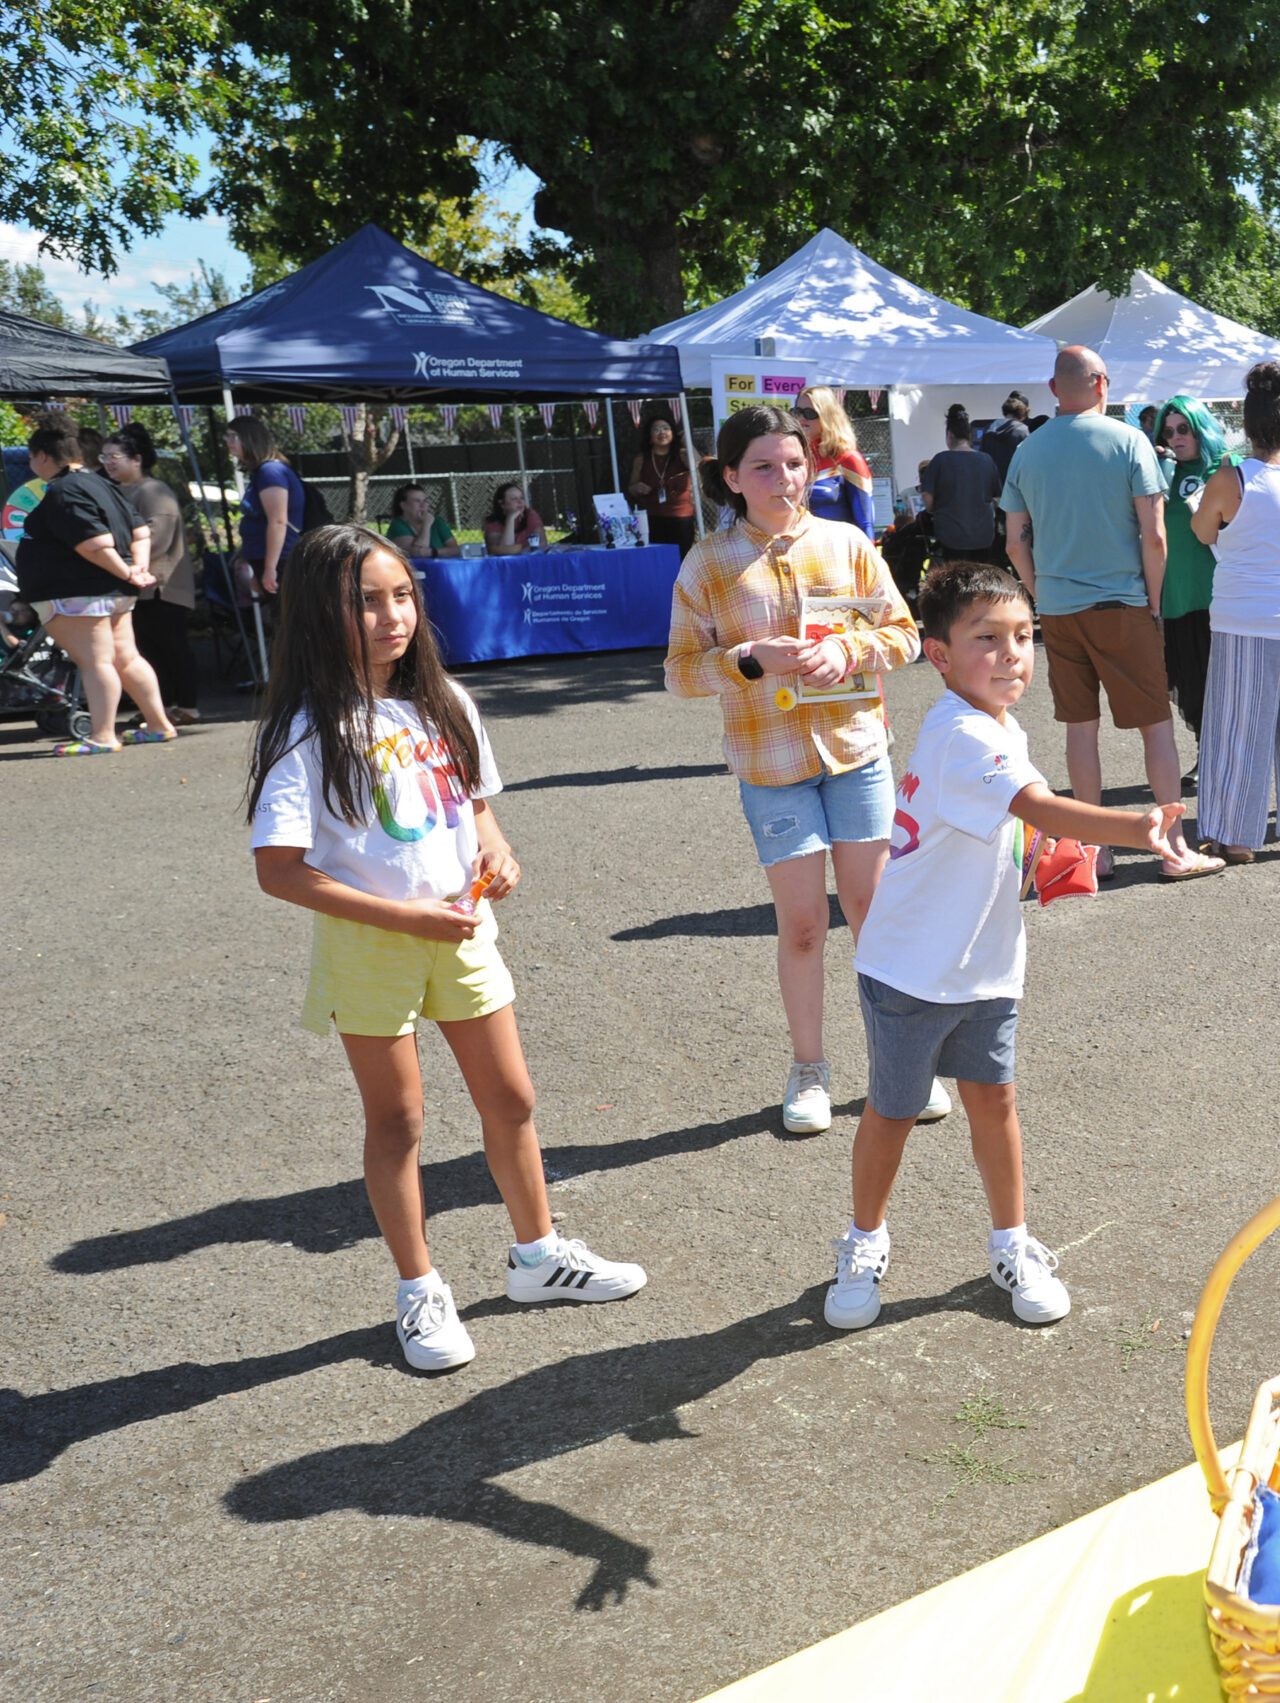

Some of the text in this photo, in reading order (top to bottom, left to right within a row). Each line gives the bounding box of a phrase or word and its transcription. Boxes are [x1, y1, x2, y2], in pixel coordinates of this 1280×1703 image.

[429, 357, 523, 369] Oregon Department
[430, 368, 521, 378] of Human Services
[728, 376, 806, 391] For Every
[533, 583, 606, 593] Oregon Department
[543, 592, 570, 600] Human
[571, 591, 603, 600] Services
[364, 727, 453, 774] Tea
